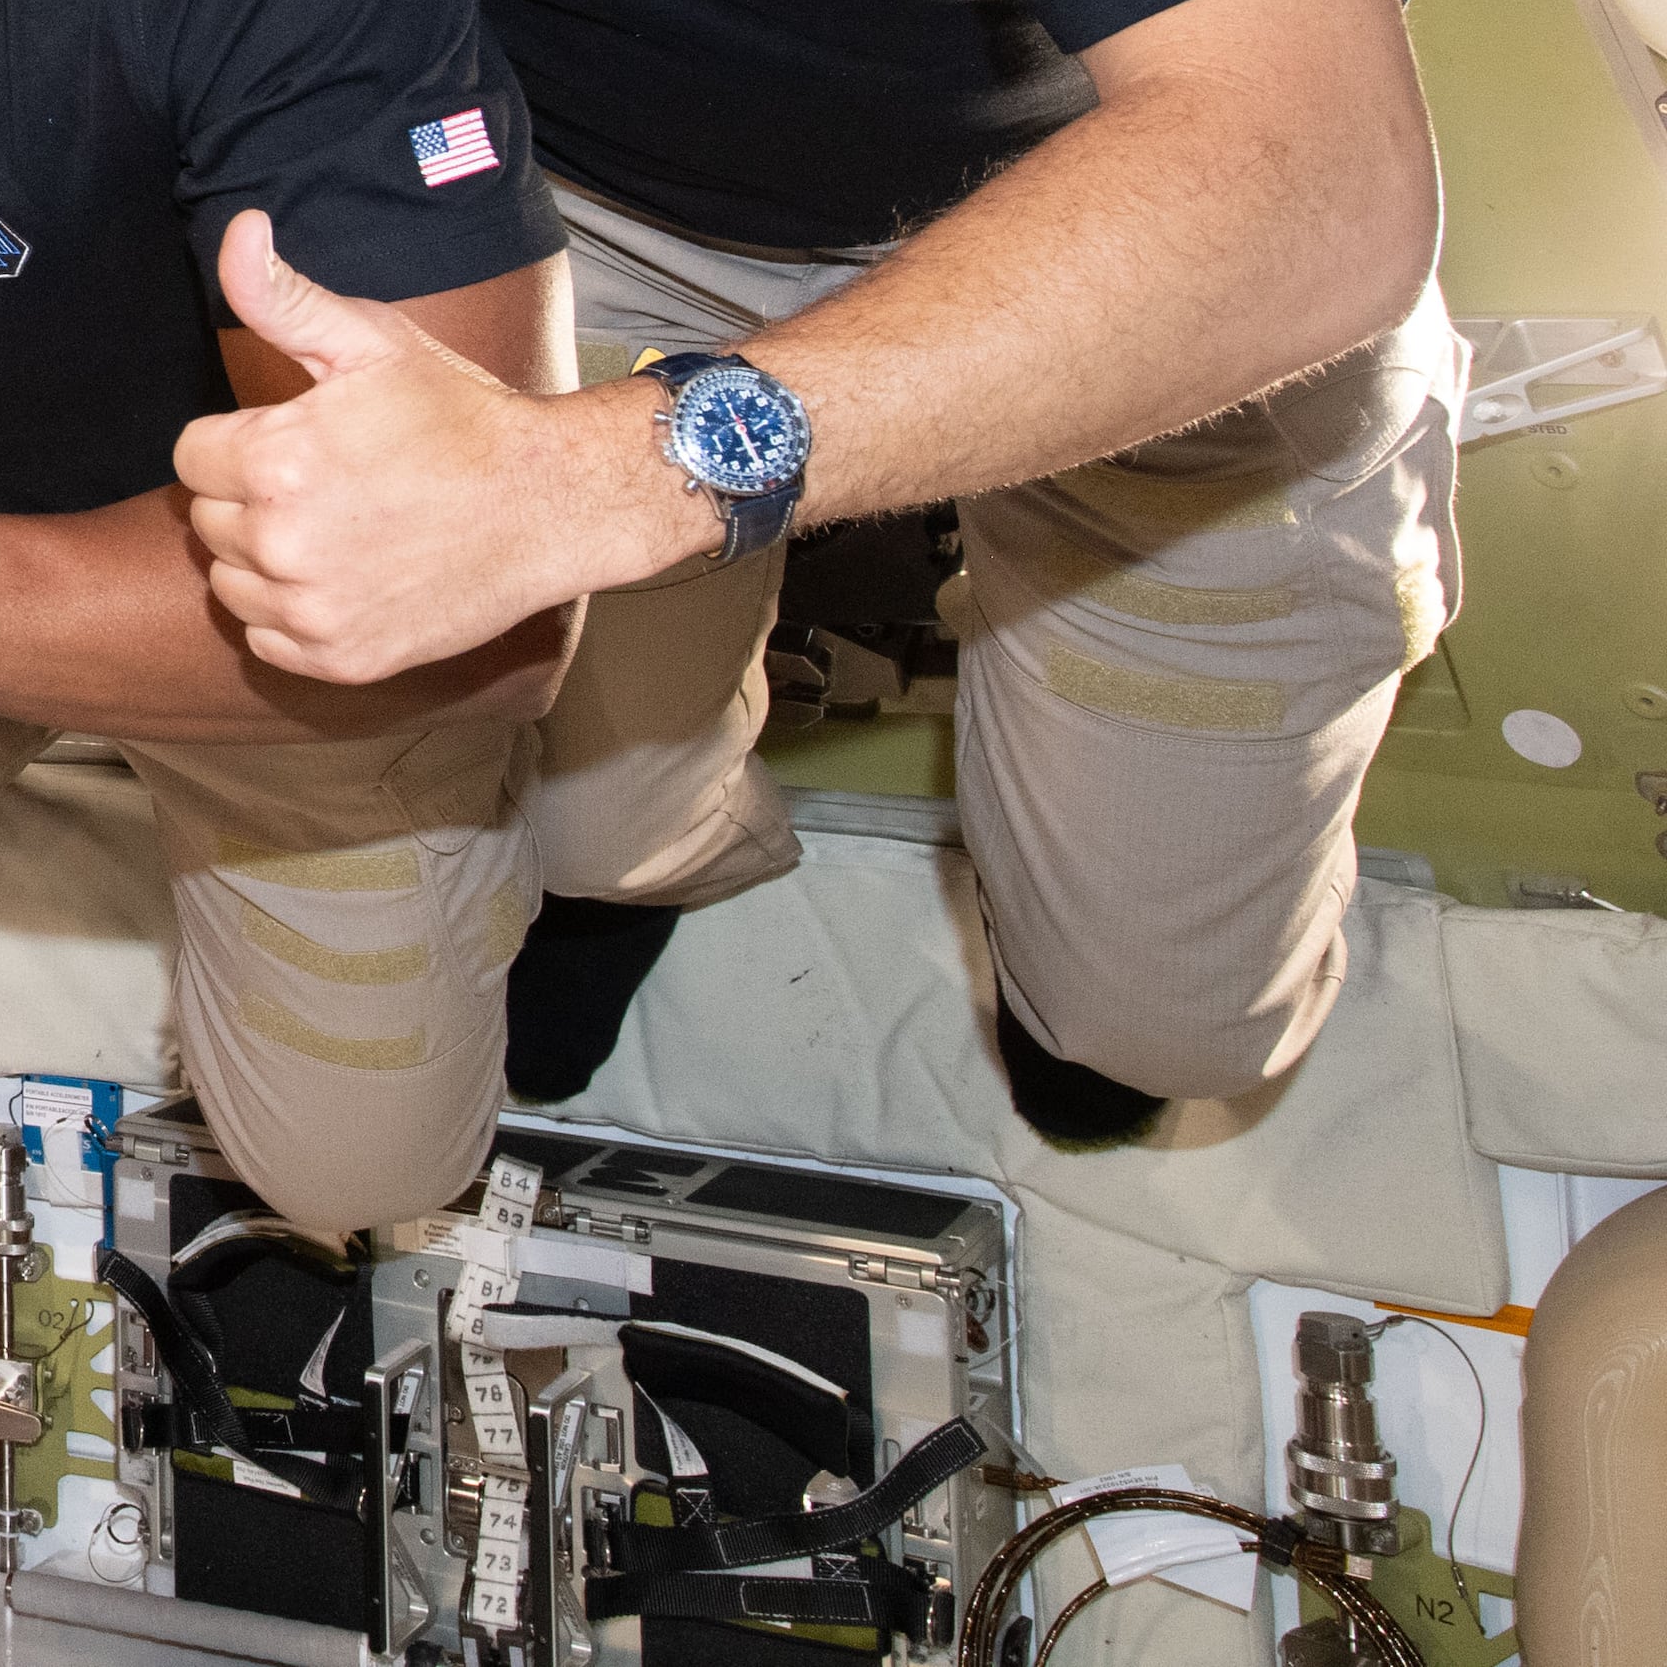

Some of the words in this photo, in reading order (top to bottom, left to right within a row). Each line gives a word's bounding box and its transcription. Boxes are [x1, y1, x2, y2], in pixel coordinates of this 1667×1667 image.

[25, 1088, 49, 1097] PORTABLE
[500, 1171, 531, 1191] 84
[496, 1207, 524, 1229] 83
[480, 1281, 504, 1303] 81
[38, 1310, 65, 1330] O2
[471, 1318, 484, 1335] 8
[483, 1427, 513, 1445] 77
[489, 1512, 518, 1530] 74
[484, 1552, 512, 1571] 73
[480, 1595, 508, 1613] 72
[1414, 1592, 1456, 1626] N2
